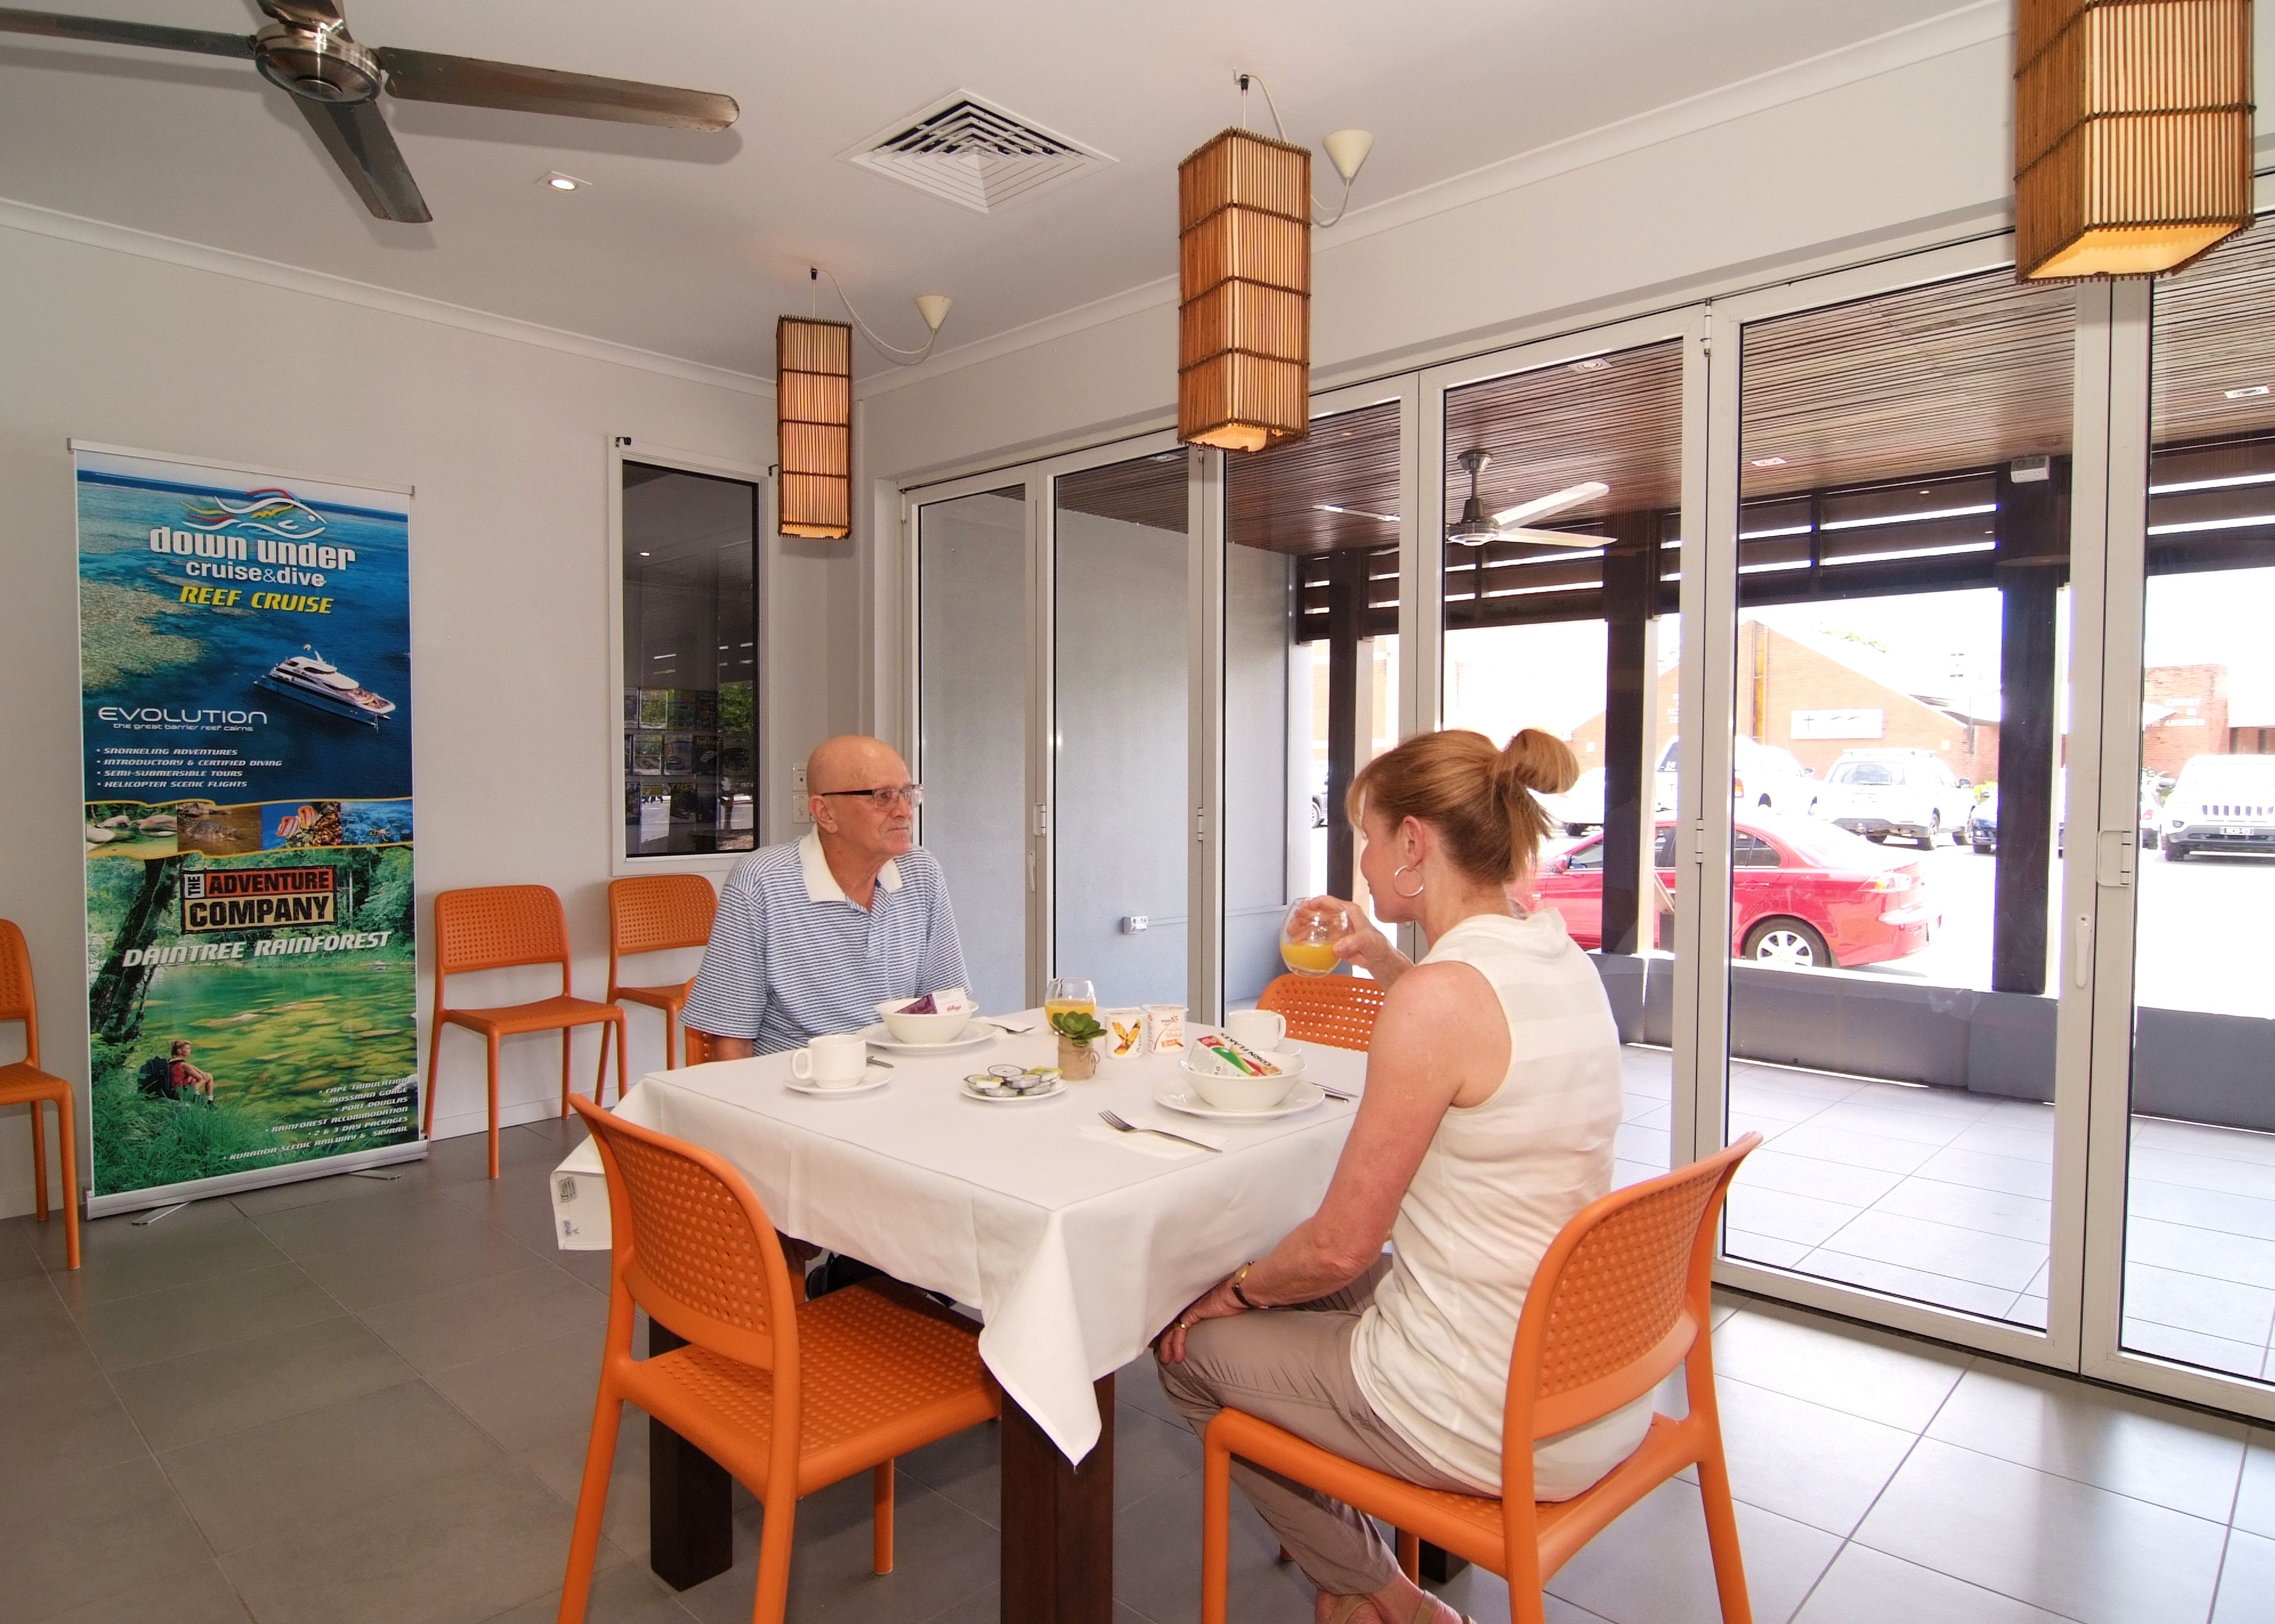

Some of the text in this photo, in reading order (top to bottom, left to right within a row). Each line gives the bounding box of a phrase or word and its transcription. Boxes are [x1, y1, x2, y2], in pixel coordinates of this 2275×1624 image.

[150, 527, 355, 570] down under
[185, 561, 326, 587] cruise&dive
[180, 586, 334, 614] REEF CRUISE
[98, 707, 267, 724] EVOLUTION
[187, 876, 201, 896] THE
[209, 871, 329, 894] ADVENTURE
[190, 896, 329, 927] COMPANY
[122, 931, 392, 968] DAINTREE RAINFOREST
[1220, 1032, 1249, 1052] FLAKES
[1248, 1051, 1272, 1067] CORN
[352, 1077, 409, 1090] TRIBULATION
[329, 1087, 408, 1103] MOSSMAN GORGE
[341, 1097, 408, 1112] PORT DOUGLAS
[271, 1106, 408, 1132] RAINFOREST ACCOMMODATION
[342, 1123, 361, 1132] DAY
[364, 1116, 408, 1128] PACKAGES
[229, 1147, 277, 1160] KURANDA
[280, 1141, 311, 1152] SCENIC
[315, 1135, 357, 1146] RAILWAY
[371, 1126, 408, 1137] SKYRAIL
